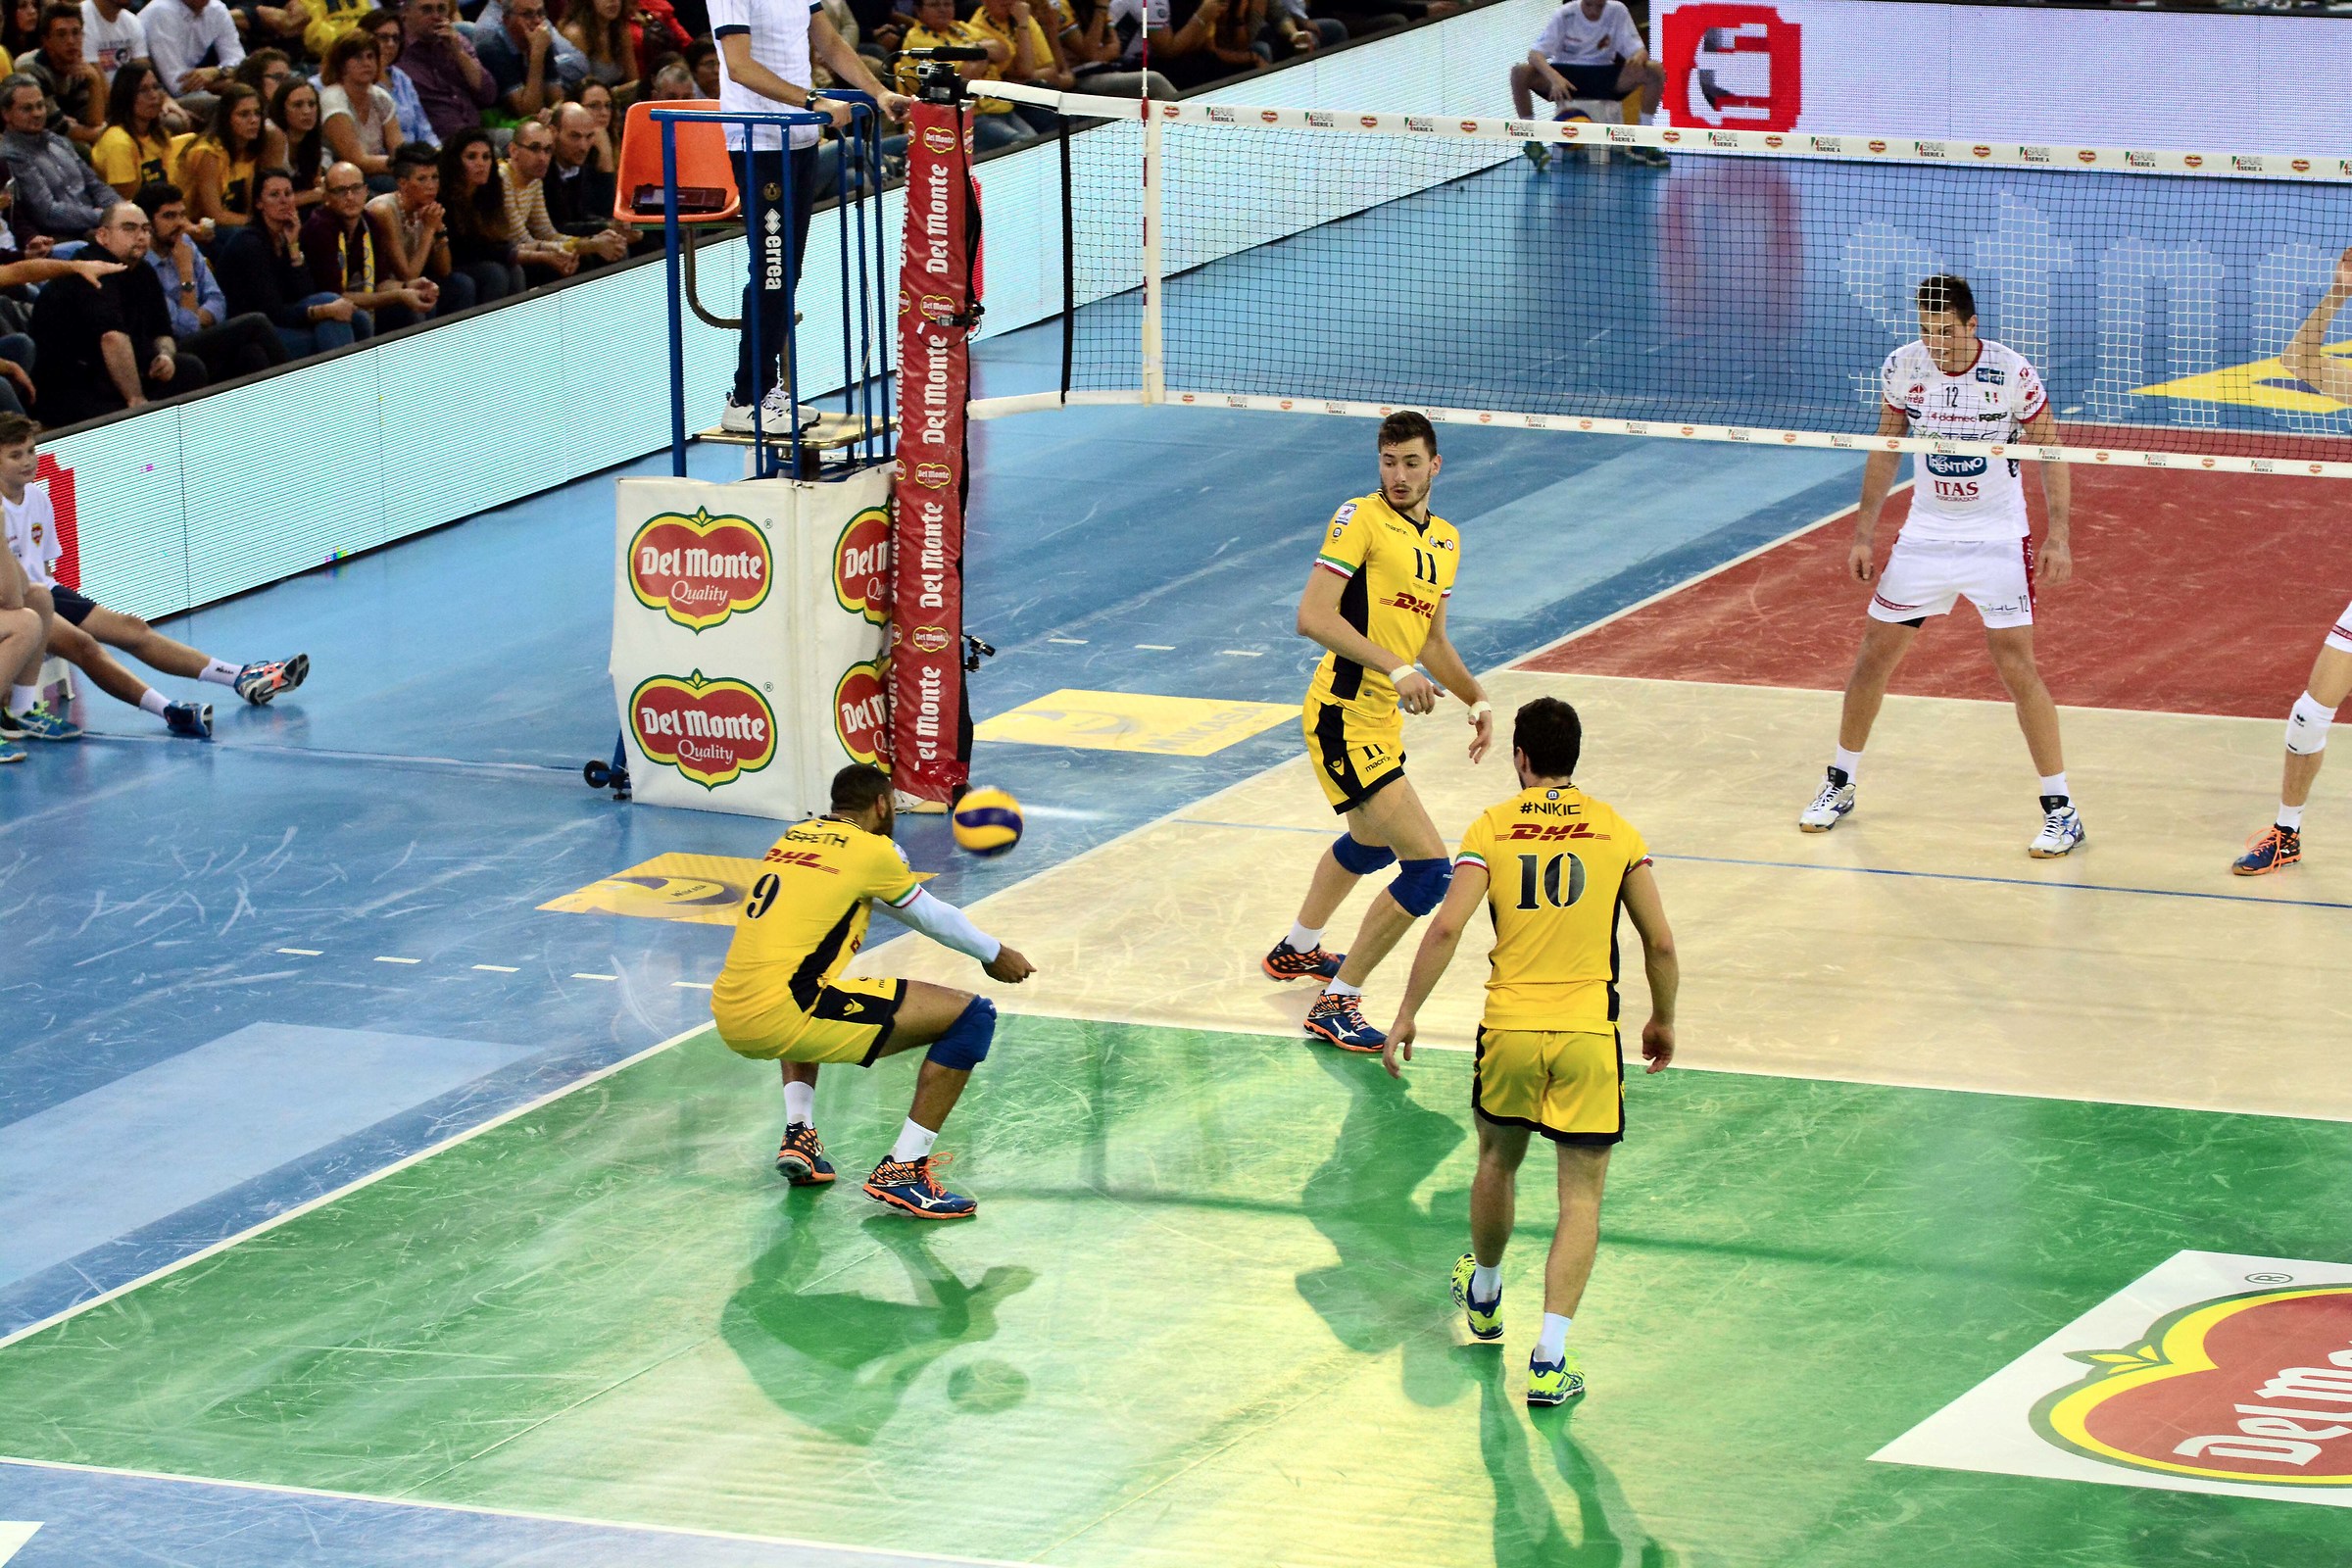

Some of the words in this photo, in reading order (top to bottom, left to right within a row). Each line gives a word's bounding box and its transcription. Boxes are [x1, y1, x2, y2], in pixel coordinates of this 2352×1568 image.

[926, 164, 949, 235] Monte
[925, 239, 949, 273] Del
[924, 334, 949, 406] Monte
[1945, 386, 1959, 408] 12
[922, 409, 947, 445] Del
[1935, 479, 1979, 496] ITAS
[921, 501, 944, 571] Monte
[641, 546, 681, 577] Del
[684, 548, 762, 580] Monte
[845, 543, 875, 579] Del
[1413, 547, 1438, 586] 11
[671, 580, 728, 607] Quality
[919, 573, 944, 609] Del
[2019, 594, 2030, 613] 12
[842, 698, 875, 734] Del
[916, 665, 942, 737] Monte
[641, 707, 683, 736] Del
[683, 710, 765, 742] Monte
[677, 739, 733, 765] Quality
[914, 740, 938, 771] el
[1361, 743, 1385, 760] 11
[1509, 822, 1595, 842] DHL
[763, 848, 822, 869] DHL
[746, 873, 781, 919] 9
[1515, 852, 1587, 910] 10
[2172, 1402, 2352, 1467] Del
